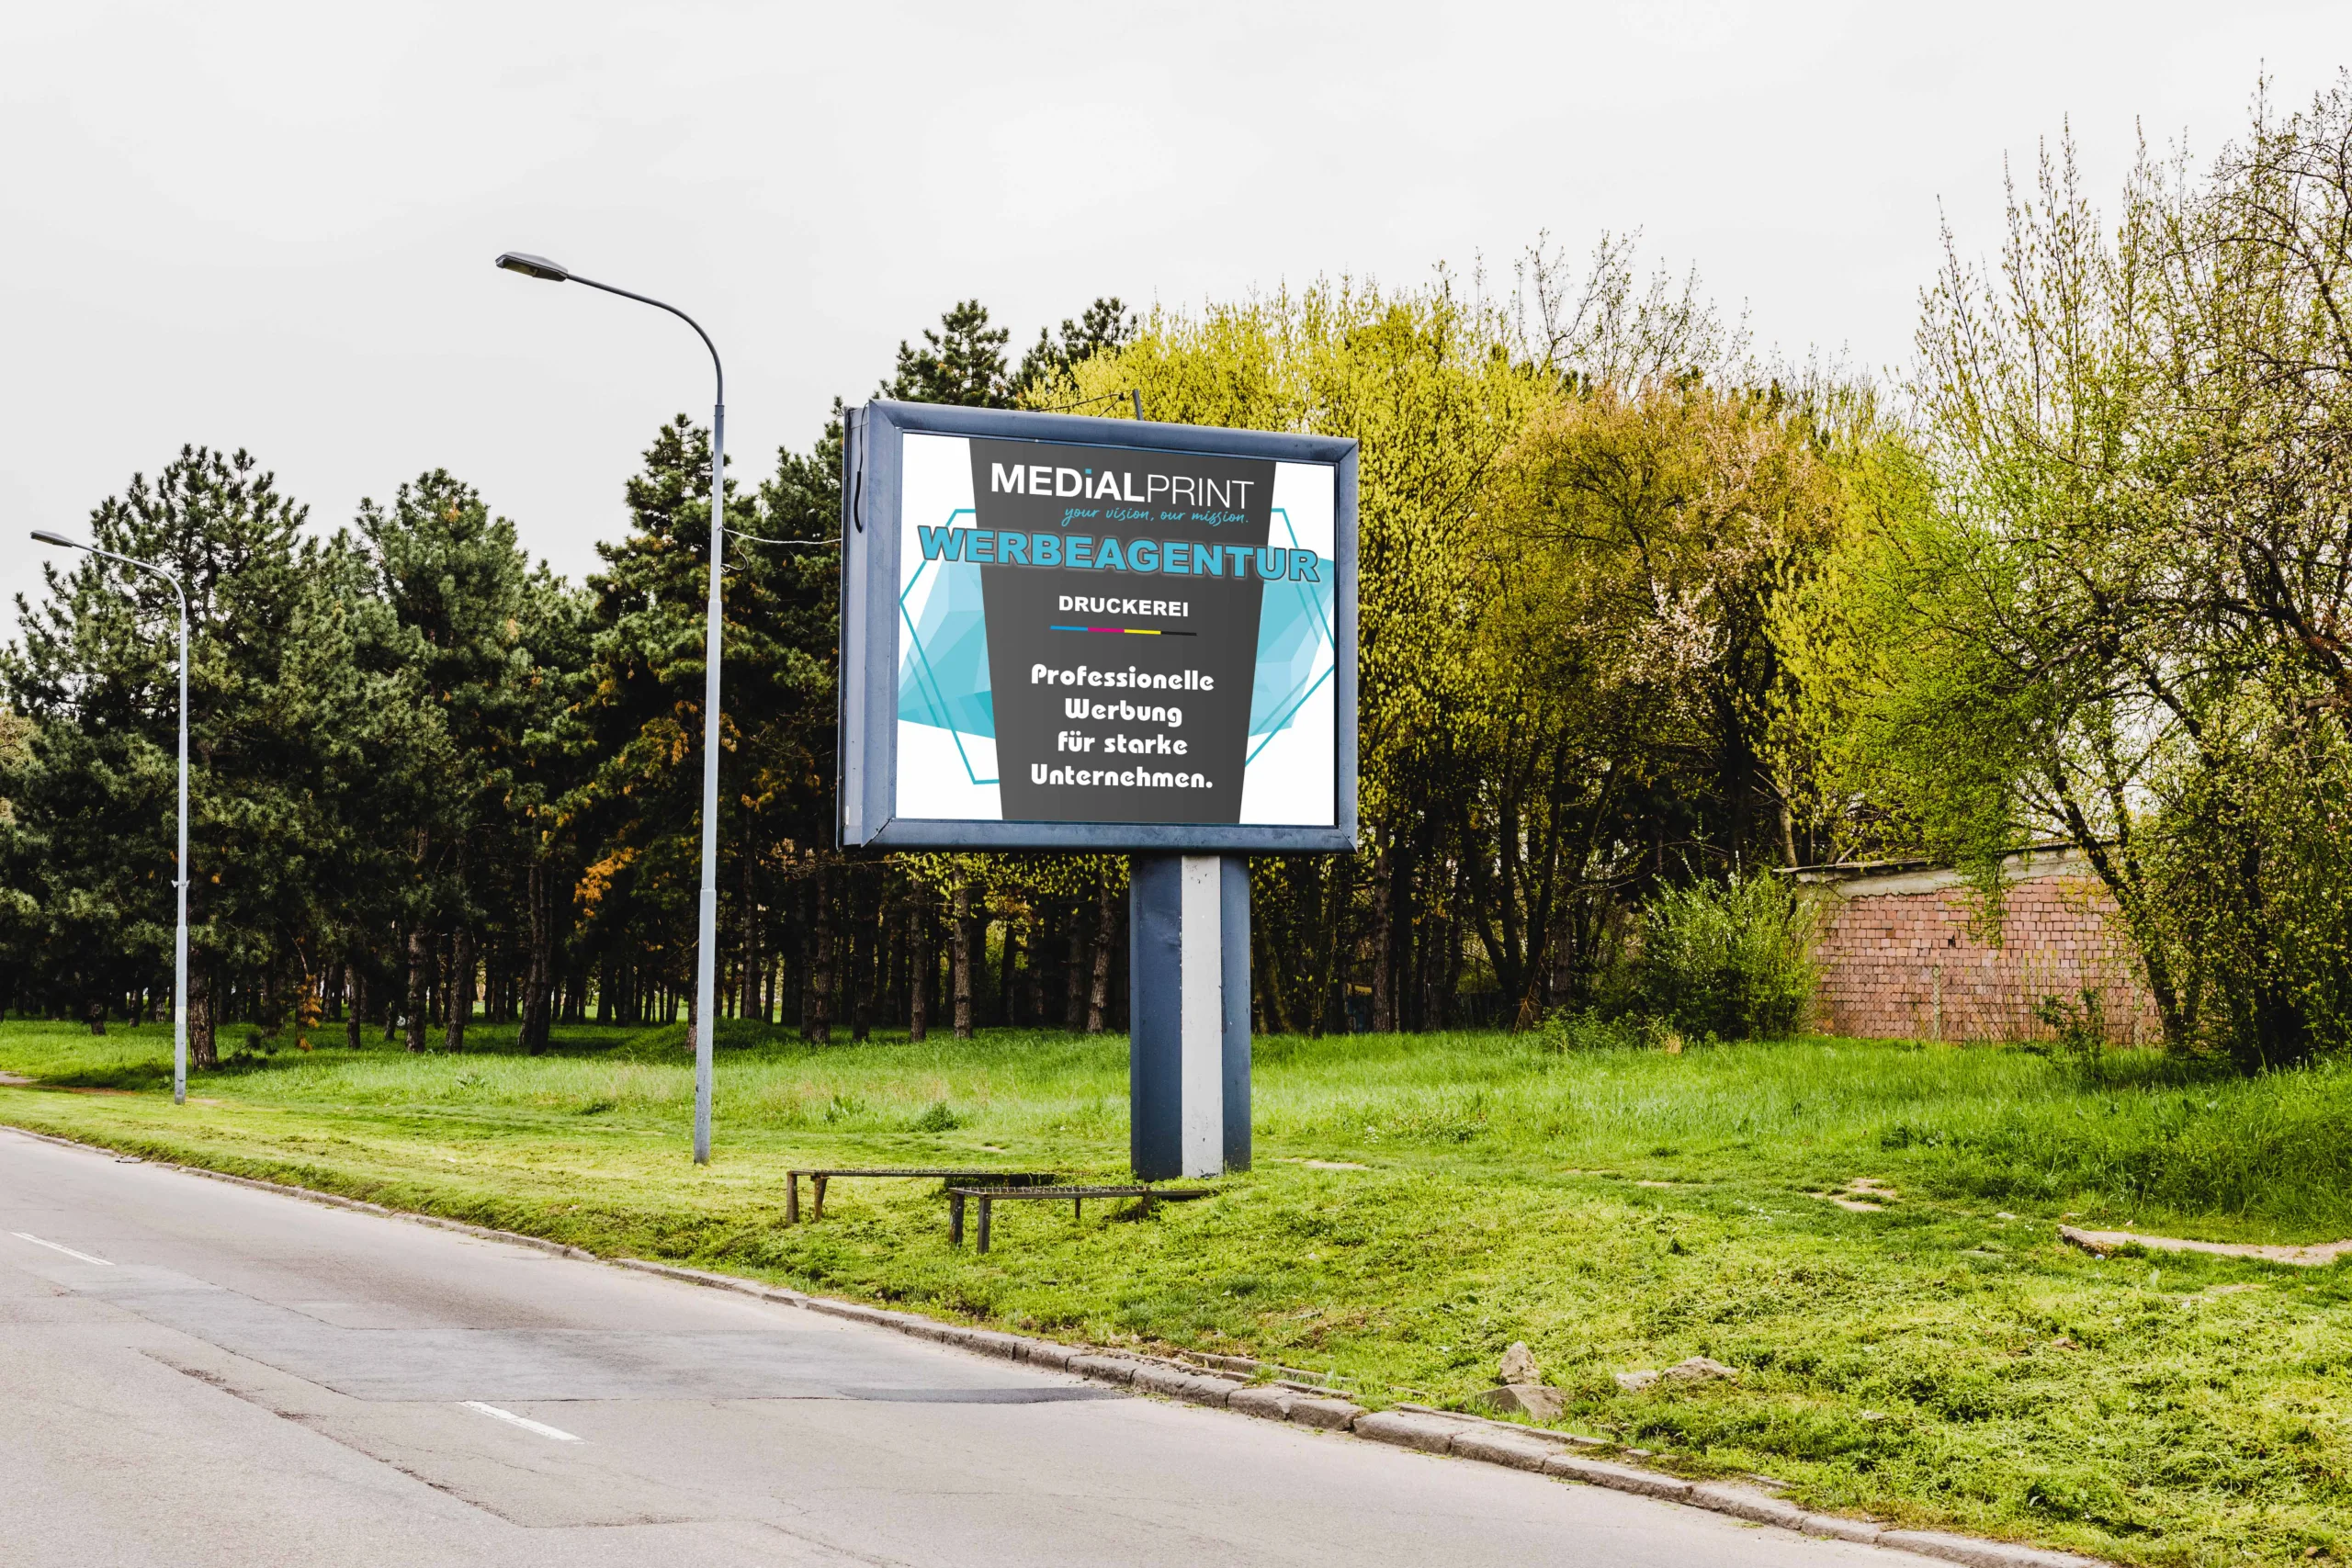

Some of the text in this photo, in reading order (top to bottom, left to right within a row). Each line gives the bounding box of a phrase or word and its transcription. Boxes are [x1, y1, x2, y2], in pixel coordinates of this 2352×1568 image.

[1061, 507, 1250, 527] your vision, our mission.
[918, 525, 1320, 582] WERBEAGENTUR
[1058, 595, 1189, 617] DRUCKEREI
[1031, 663, 1215, 691] Professionelle
[1065, 698, 1182, 728] Werbung
[1057, 730, 1188, 755] für starke
[1031, 763, 1213, 788] Unternehmen.
